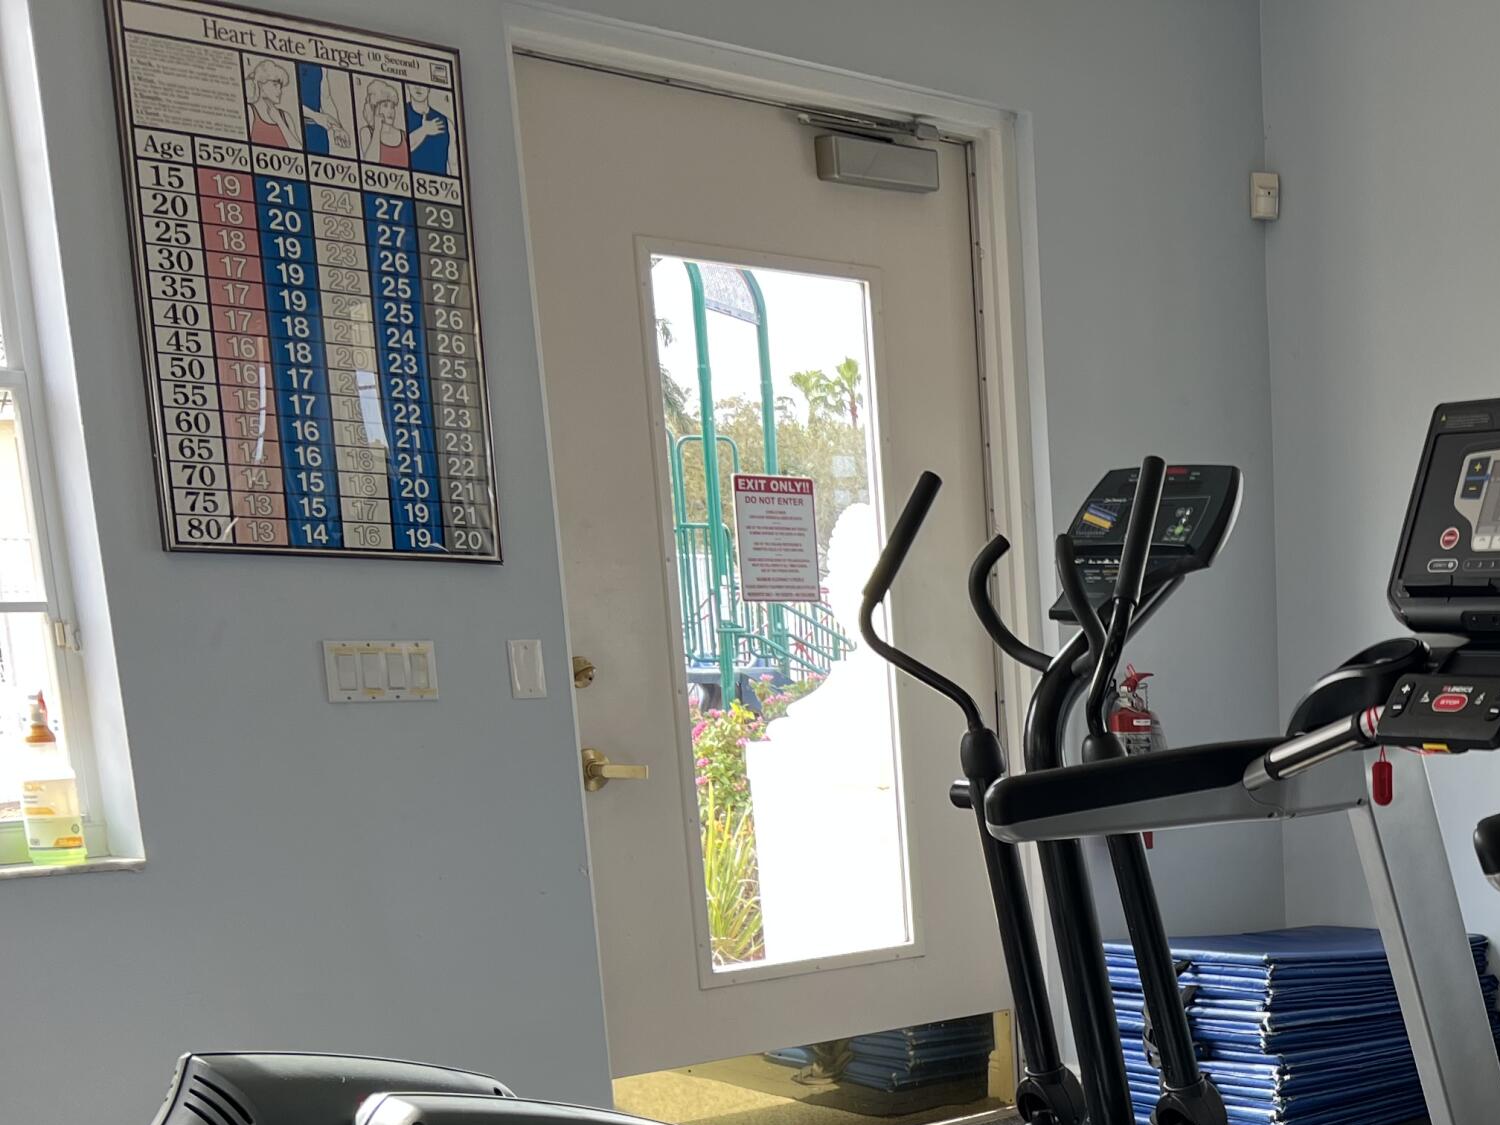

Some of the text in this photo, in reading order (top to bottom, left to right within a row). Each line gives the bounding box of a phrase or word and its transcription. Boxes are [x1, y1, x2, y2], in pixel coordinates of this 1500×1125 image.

[202, 18, 365, 68] Heart Rate Target
[368, 51, 420, 70] (10 Second)
[380, 62, 408, 77] Count
[143, 134, 459, 200] Age 55% 60% 70% 80% 85%
[150, 165, 454, 229] 15 19 21 24 27 29
[152, 192, 456, 255] 20 18 20 23 27 28
[154, 220, 459, 280] 25 18 19 23 26 28
[157, 248, 461, 305] 30 17 19 22 25 27
[159, 275, 464, 330] 35 17 19 22 25 26
[163, 304, 466, 355] 40 17 18 21 24 26
[166, 332, 468, 380] 45 16 18 20 23 25
[170, 359, 204, 380] 50
[231, 362, 256, 384] 16
[287, 368, 313, 390] 17
[390, 378, 420, 399] 23
[441, 384, 470, 405] 24
[173, 384, 207, 407] 55
[234, 388, 258, 410] 15
[290, 394, 315, 416] 17
[393, 403, 422, 425] 22
[443, 408, 472, 428] 23
[176, 411, 210, 433] 60
[236, 415, 258, 436] 15
[292, 420, 319, 441] 16
[395, 429, 422, 450] 21
[445, 433, 473, 453] 23
[179, 438, 213, 459] 65
[295, 445, 322, 467] 16
[346, 449, 373, 471] 18
[398, 453, 424, 474] 21
[448, 457, 475, 477] 22
[181, 464, 475, 501] 70 14 15 18 20 21
[738, 478, 810, 492] EXIT ONLY!!
[744, 496, 804, 506] DO NOT ENTER
[184, 491, 477, 526] 75 13 15 17 19 21
[187, 517, 482, 550] 80 13 14 16 19 20
